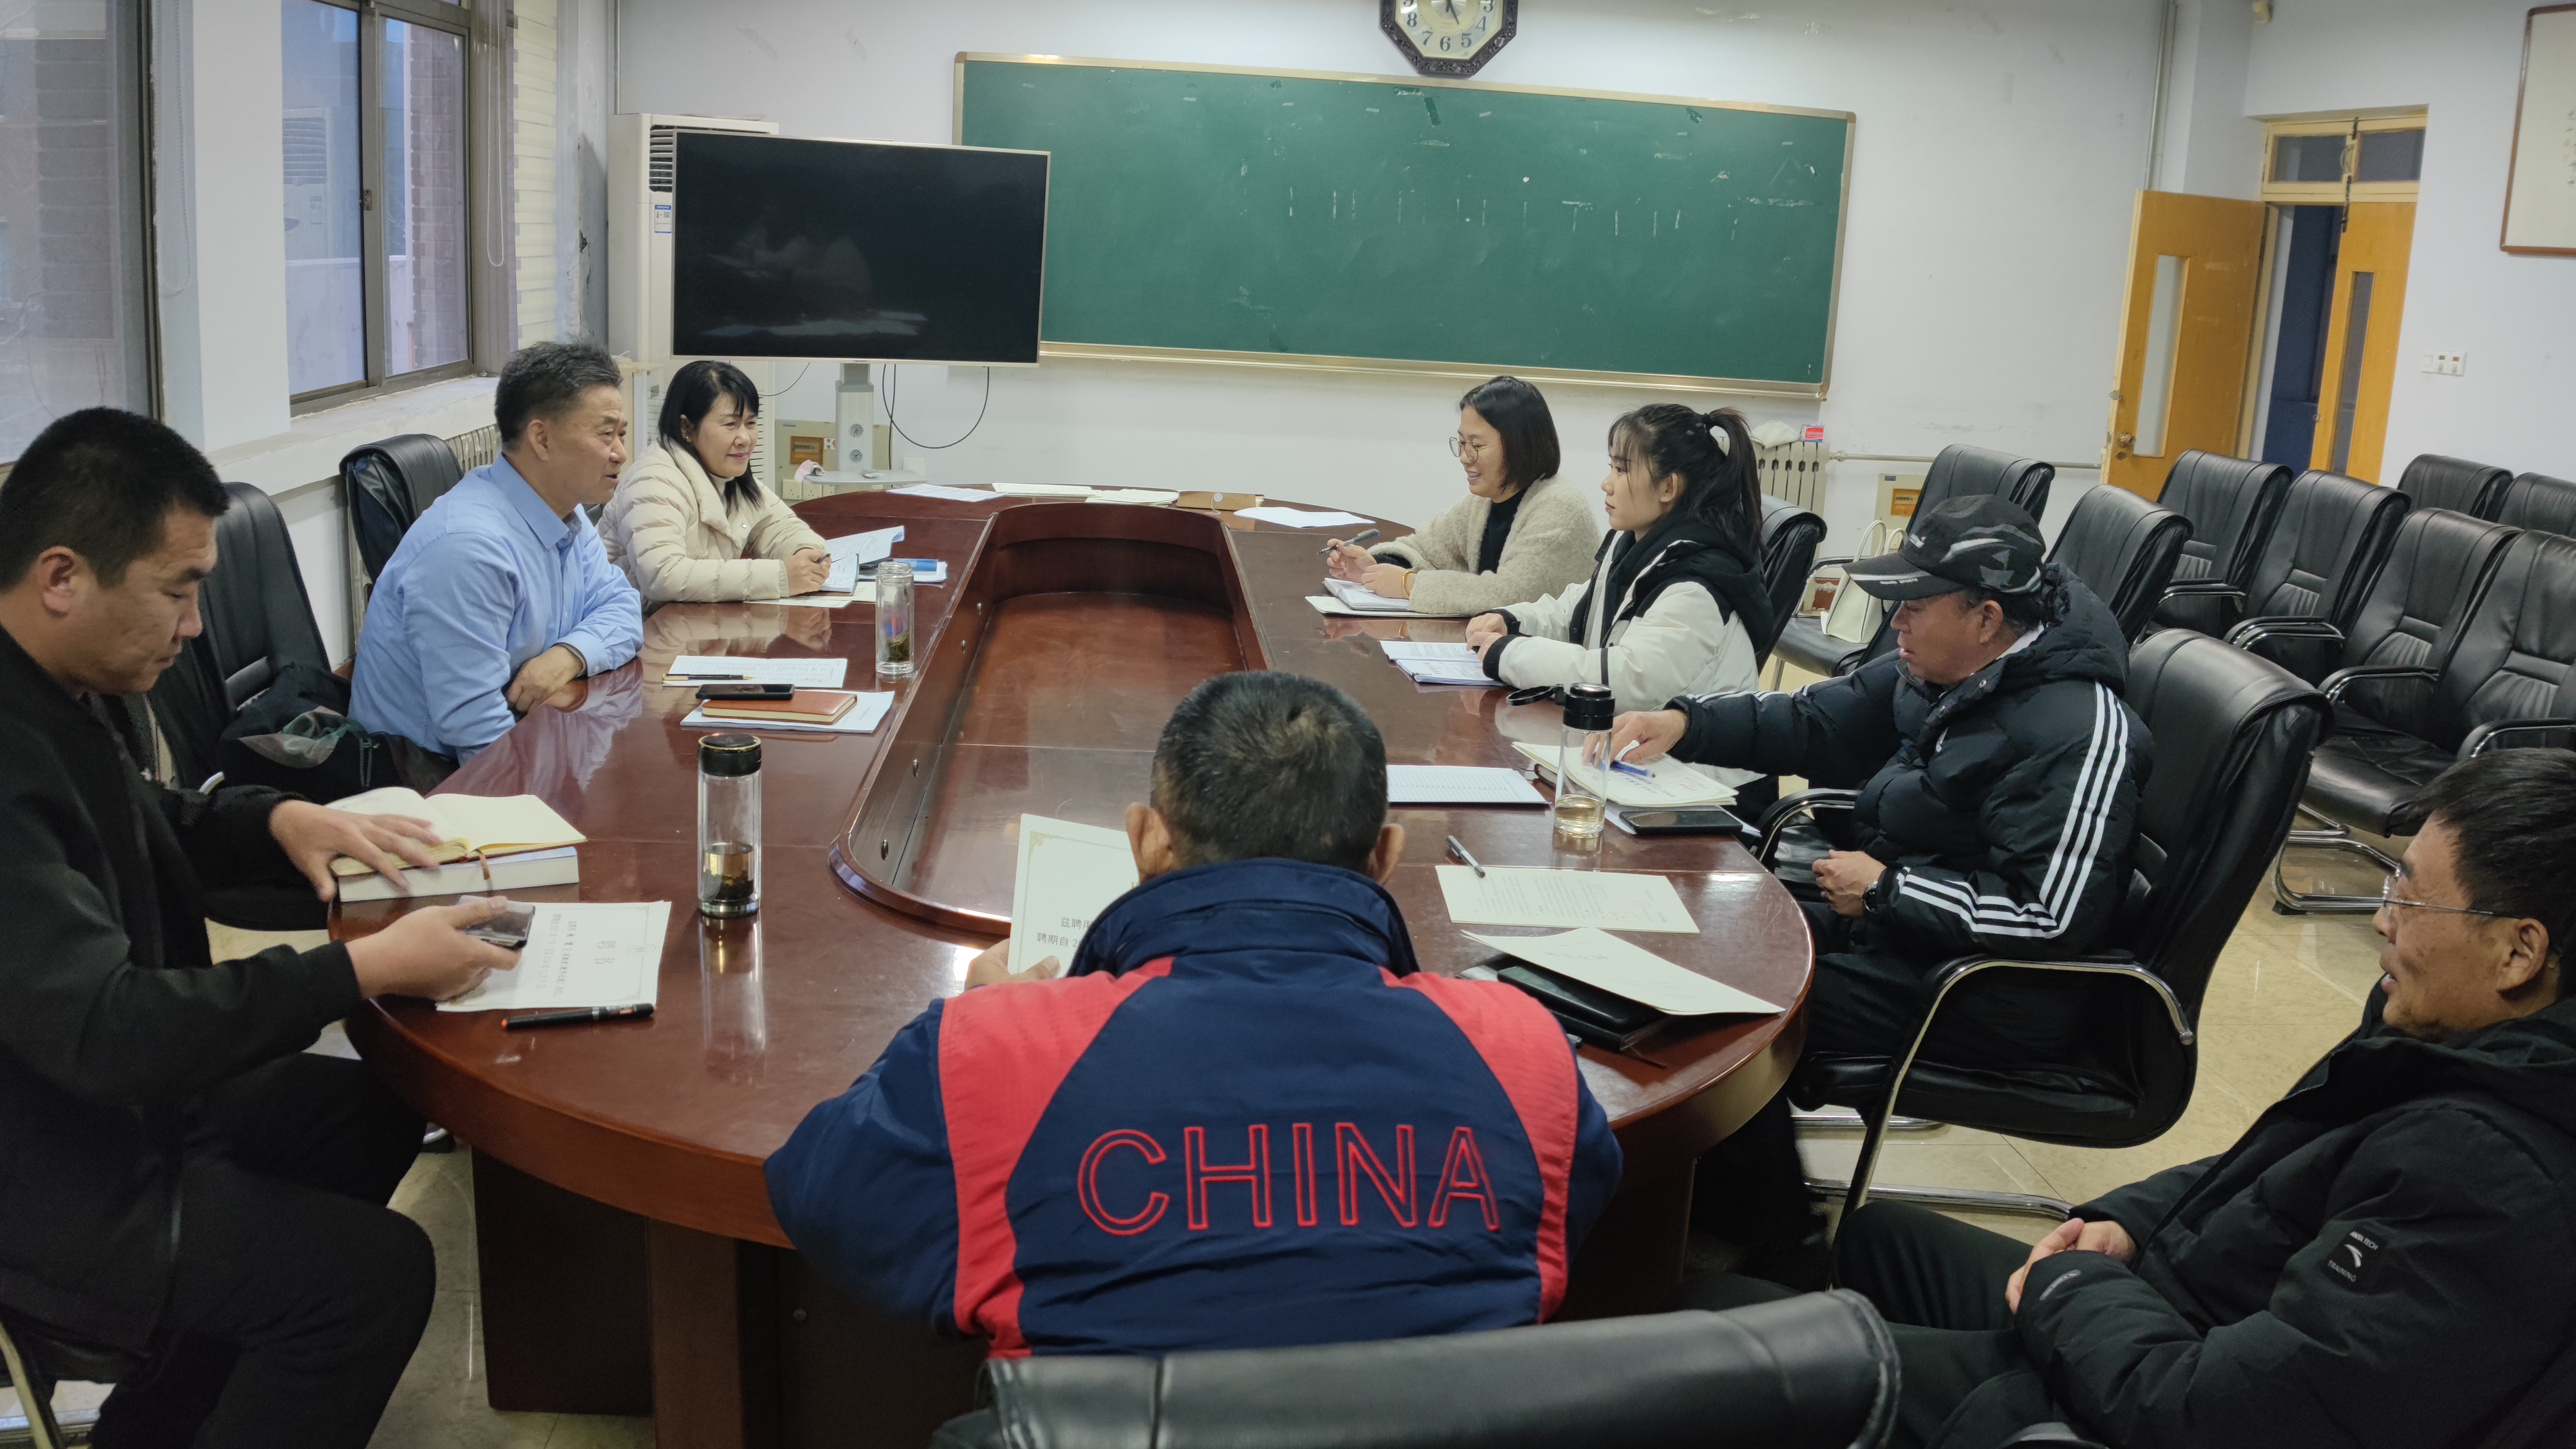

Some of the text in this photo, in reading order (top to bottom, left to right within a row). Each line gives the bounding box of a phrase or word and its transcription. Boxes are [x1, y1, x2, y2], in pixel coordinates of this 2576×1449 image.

[1483, 0, 1494, 12] 3
[1407, 12, 1417, 27] 8
[1476, 16, 1486, 31] 4
[1422, 31, 1433, 46] 7
[1440, 36, 1451, 51] 6
[1461, 33, 1472, 48] 5
[1077, 1122, 1500, 1236] CHINA
